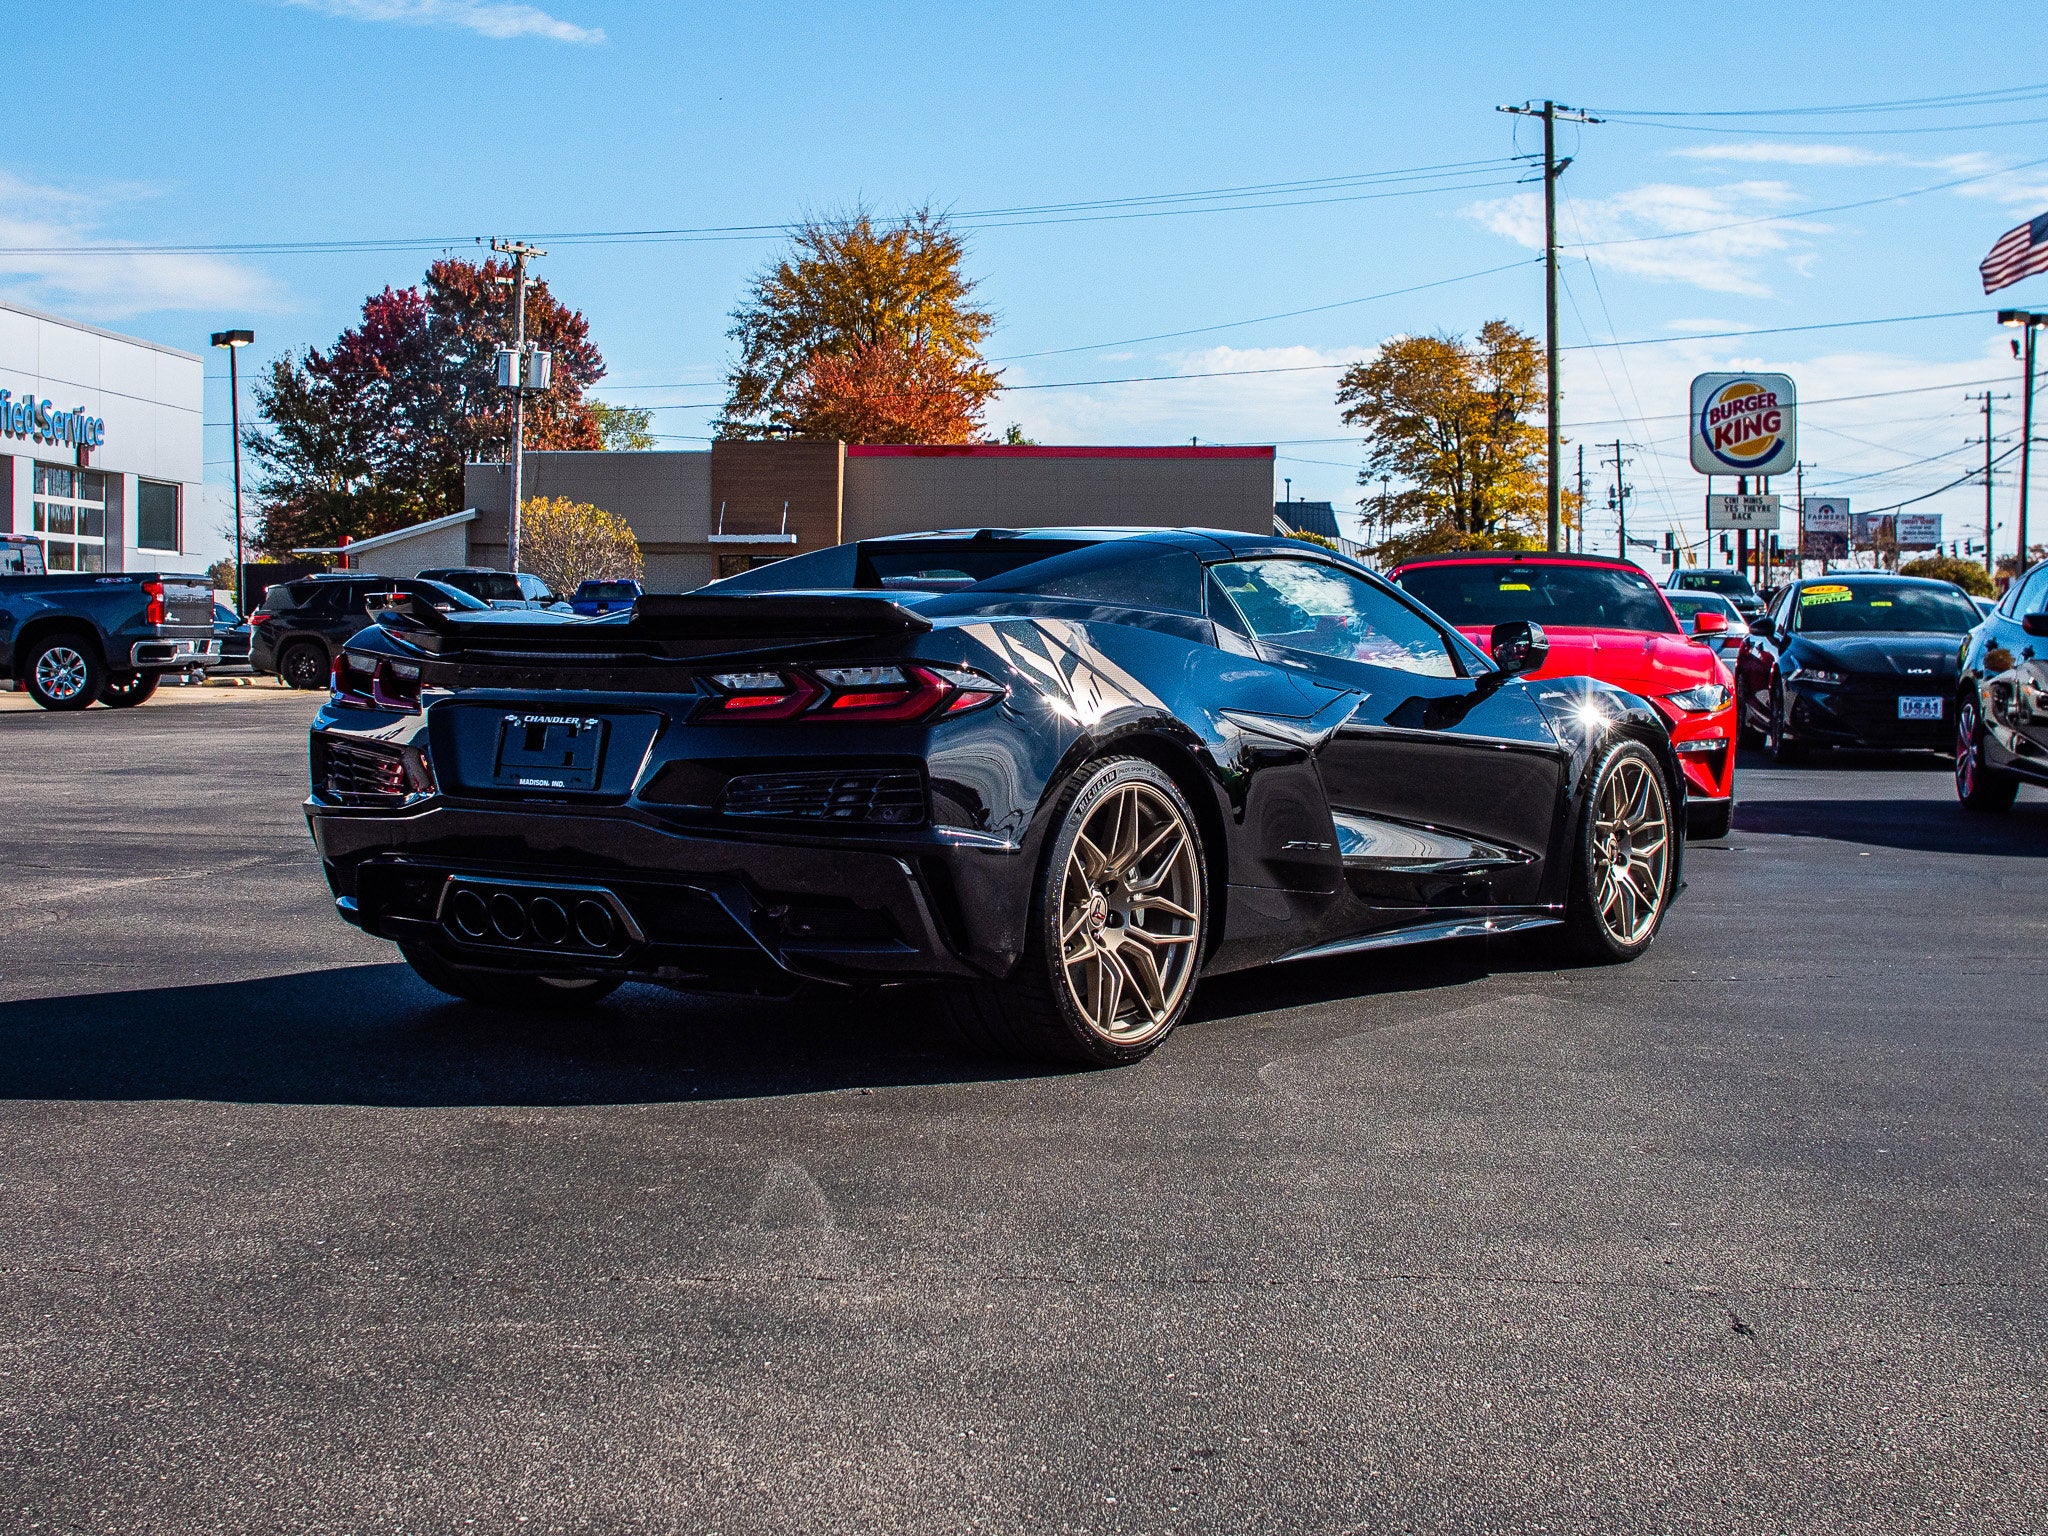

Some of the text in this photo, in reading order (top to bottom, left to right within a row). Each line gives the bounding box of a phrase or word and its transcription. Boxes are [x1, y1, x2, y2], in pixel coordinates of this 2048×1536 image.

[41, 399, 105, 446] Service
[1709, 392, 1777, 427] BURGER
[1714, 410, 1782, 451] KING
[524, 715, 580, 724] CHANDLER
[1902, 702, 1939, 714] USA1
[551, 780, 565, 788] IND.
[1079, 770, 1116, 812] MICHELIN
